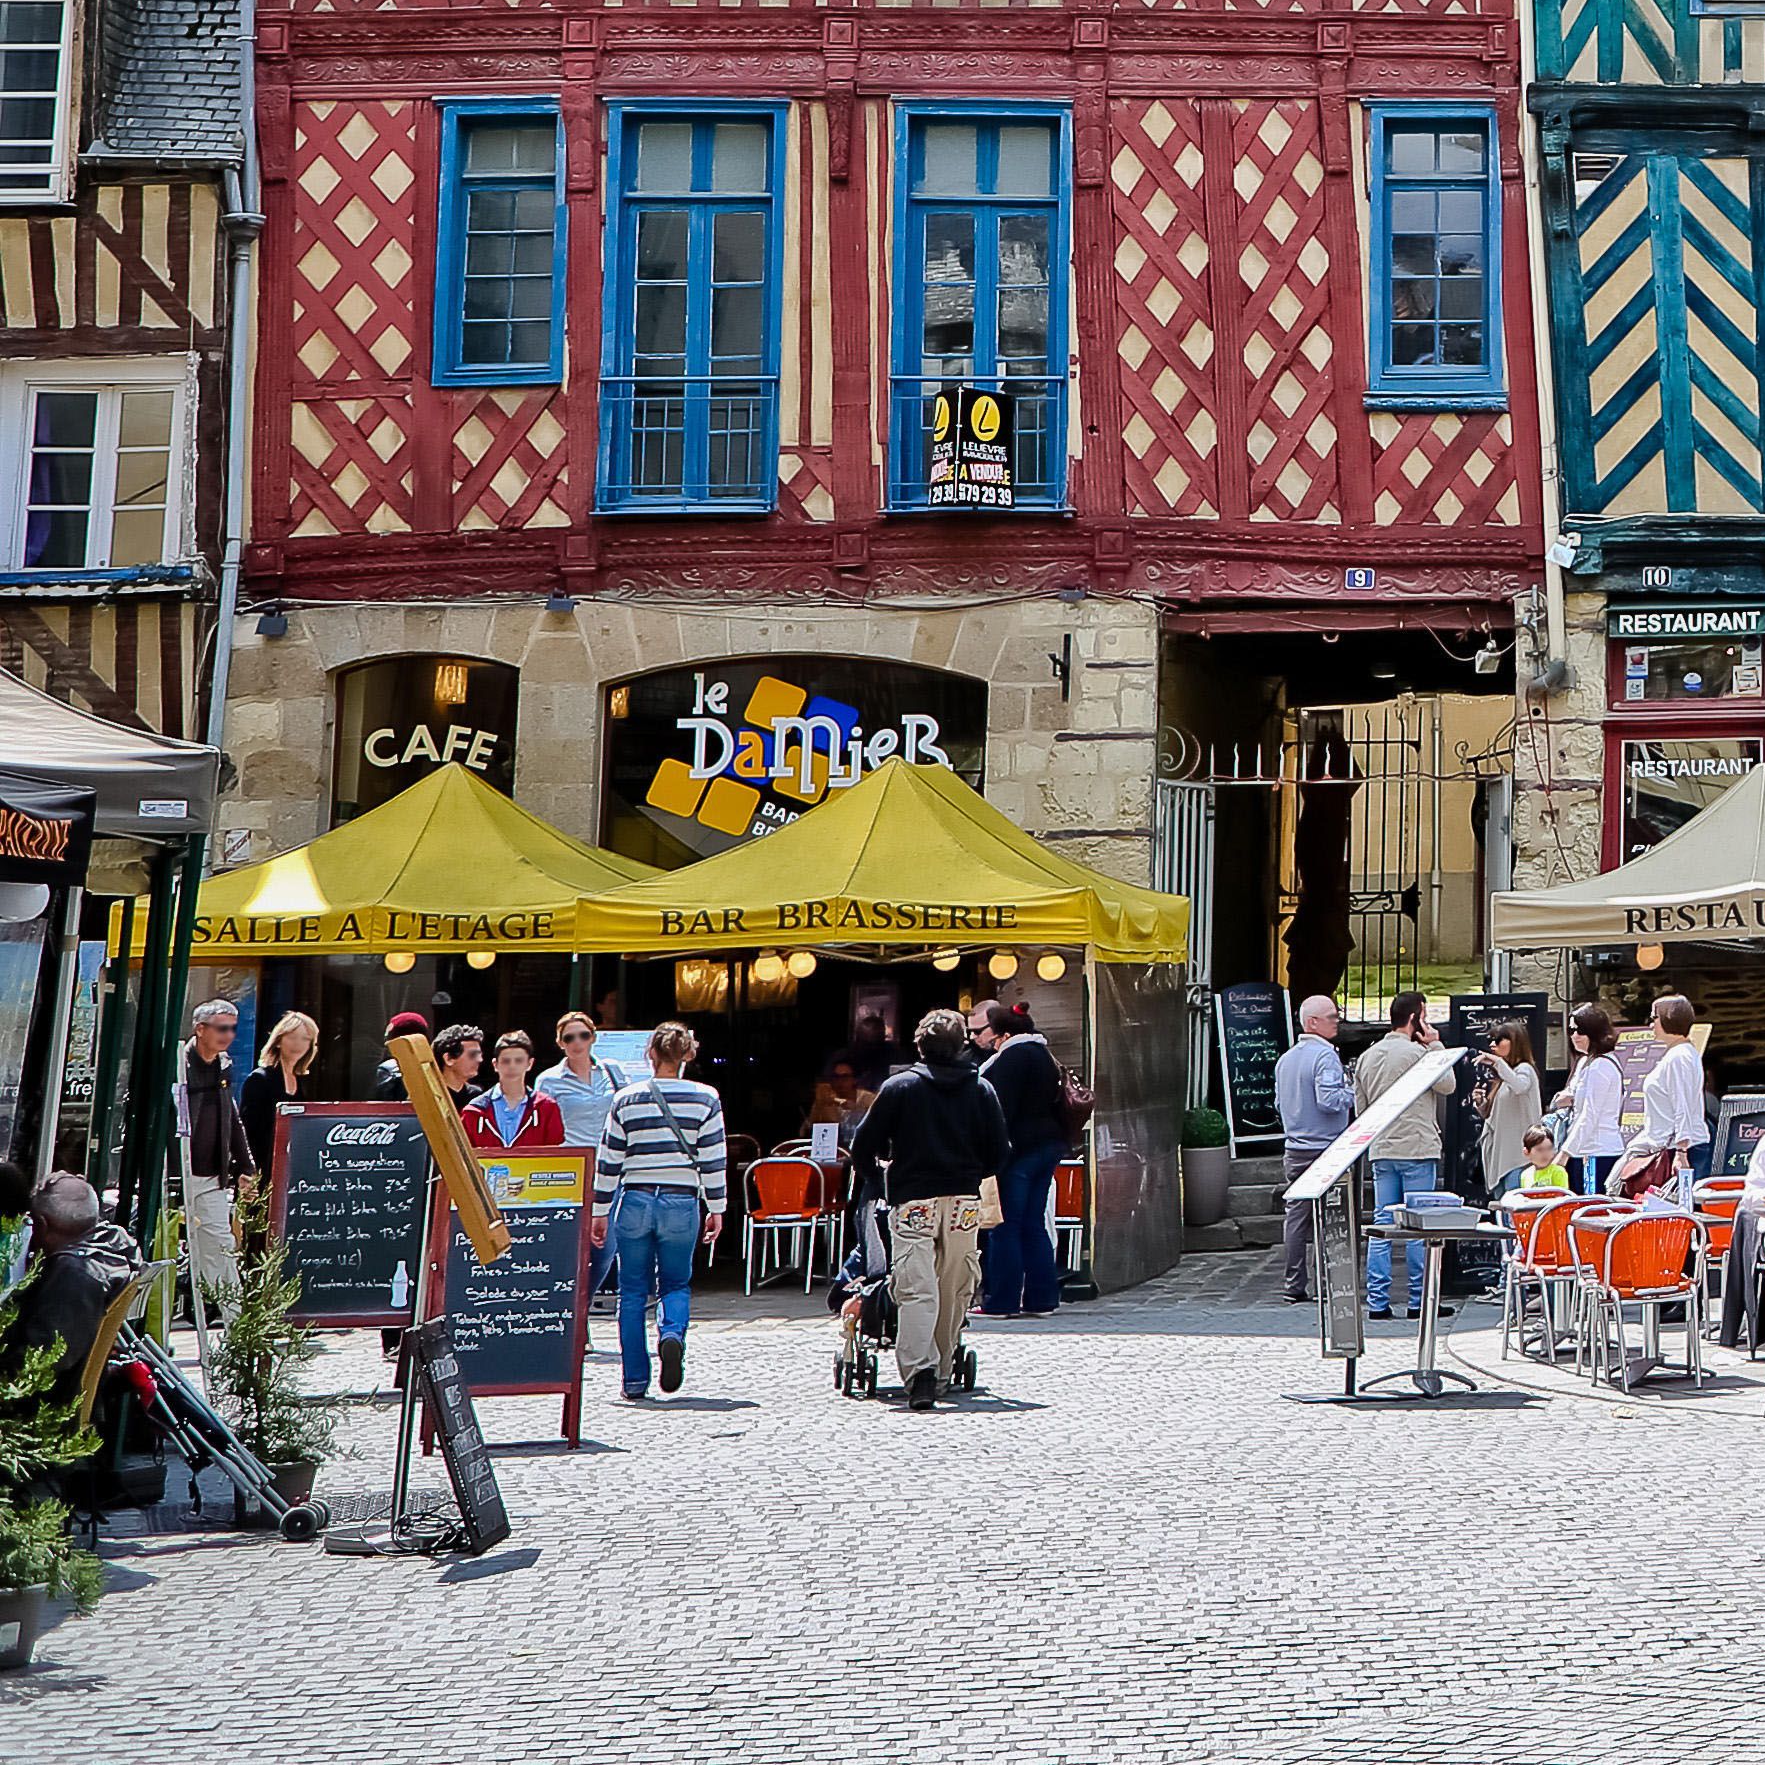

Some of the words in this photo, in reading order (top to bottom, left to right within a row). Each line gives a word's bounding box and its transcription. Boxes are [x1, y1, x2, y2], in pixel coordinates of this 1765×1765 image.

[981, 486, 996, 504] 29
[998, 488, 1012, 506] 39
[1354, 570, 1366, 587] 9
[1645, 569, 1669, 587] 10
[1618, 610, 1761, 634] RESTAURANT
[694, 672, 729, 715] le
[364, 724, 499, 772] CAFE
[1630, 757, 1754, 778] RESTAURANT
[191, 915, 321, 943] SALLE
[335, 914, 365, 941] A
[385, 911, 555, 941] L'ETAGE
[659, 906, 748, 935] BAR
[776, 899, 1019, 931] BRASSERIE
[1466, 1011, 1529, 1031] Suggestons
